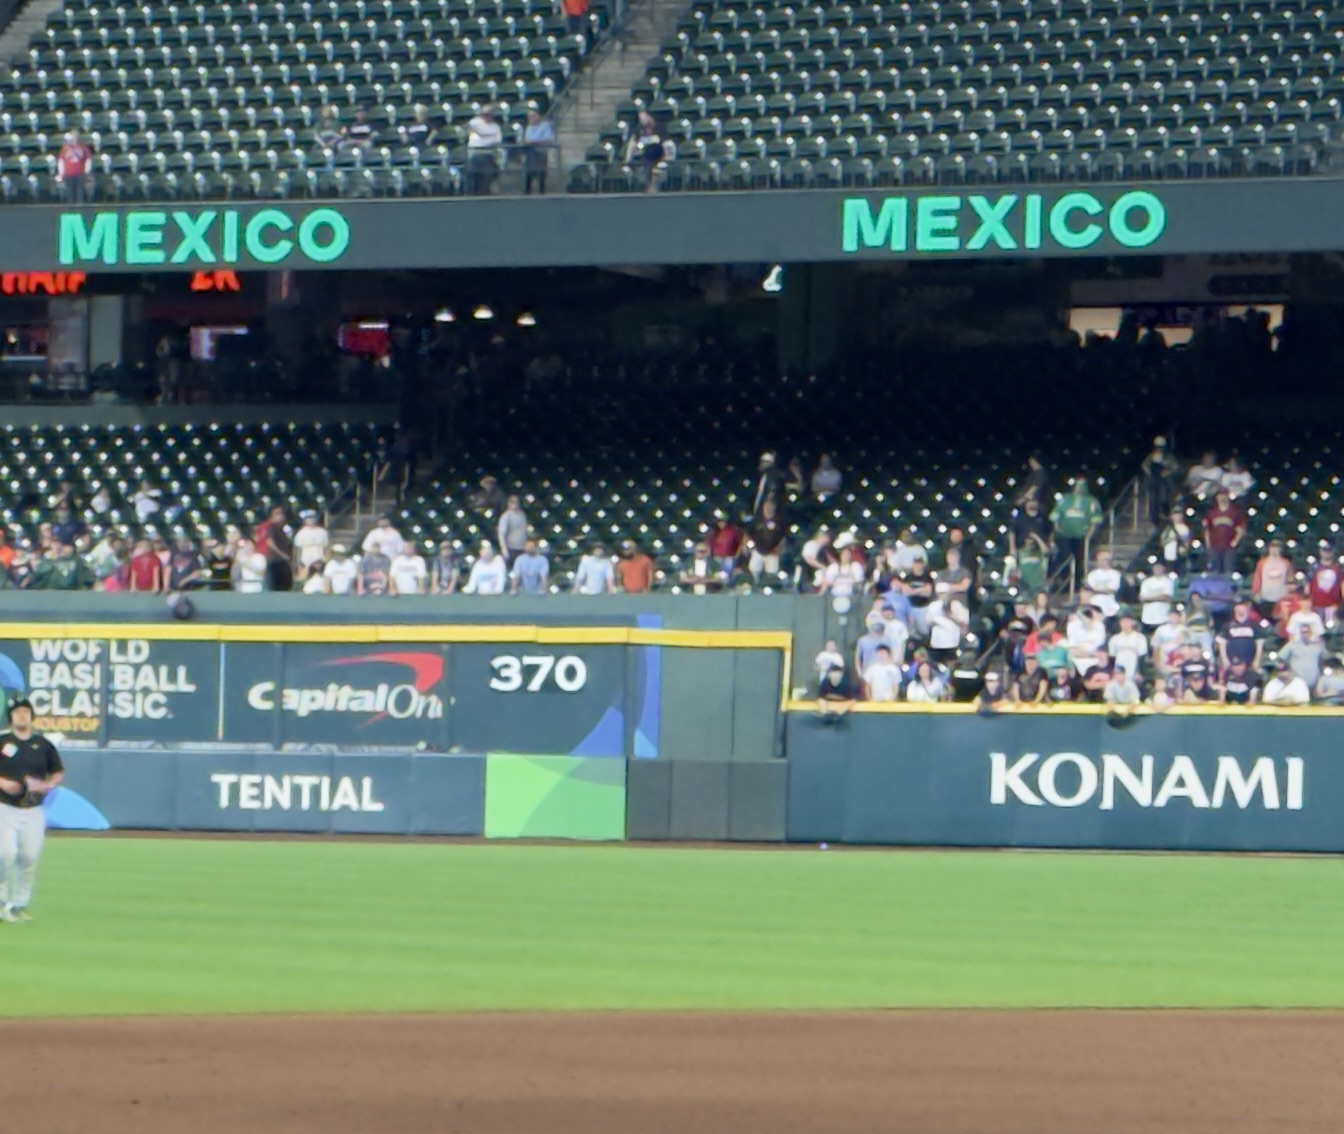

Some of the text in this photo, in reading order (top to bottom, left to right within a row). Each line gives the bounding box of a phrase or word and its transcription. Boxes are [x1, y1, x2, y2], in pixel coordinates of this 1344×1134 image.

[59, 208, 349, 264] MEXICO
[842, 190, 1165, 252] MEXICO
[490, 655, 586, 691] 370
[211, 774, 384, 811] TENTIAL
[990, 752, 1304, 810] KONAMI
